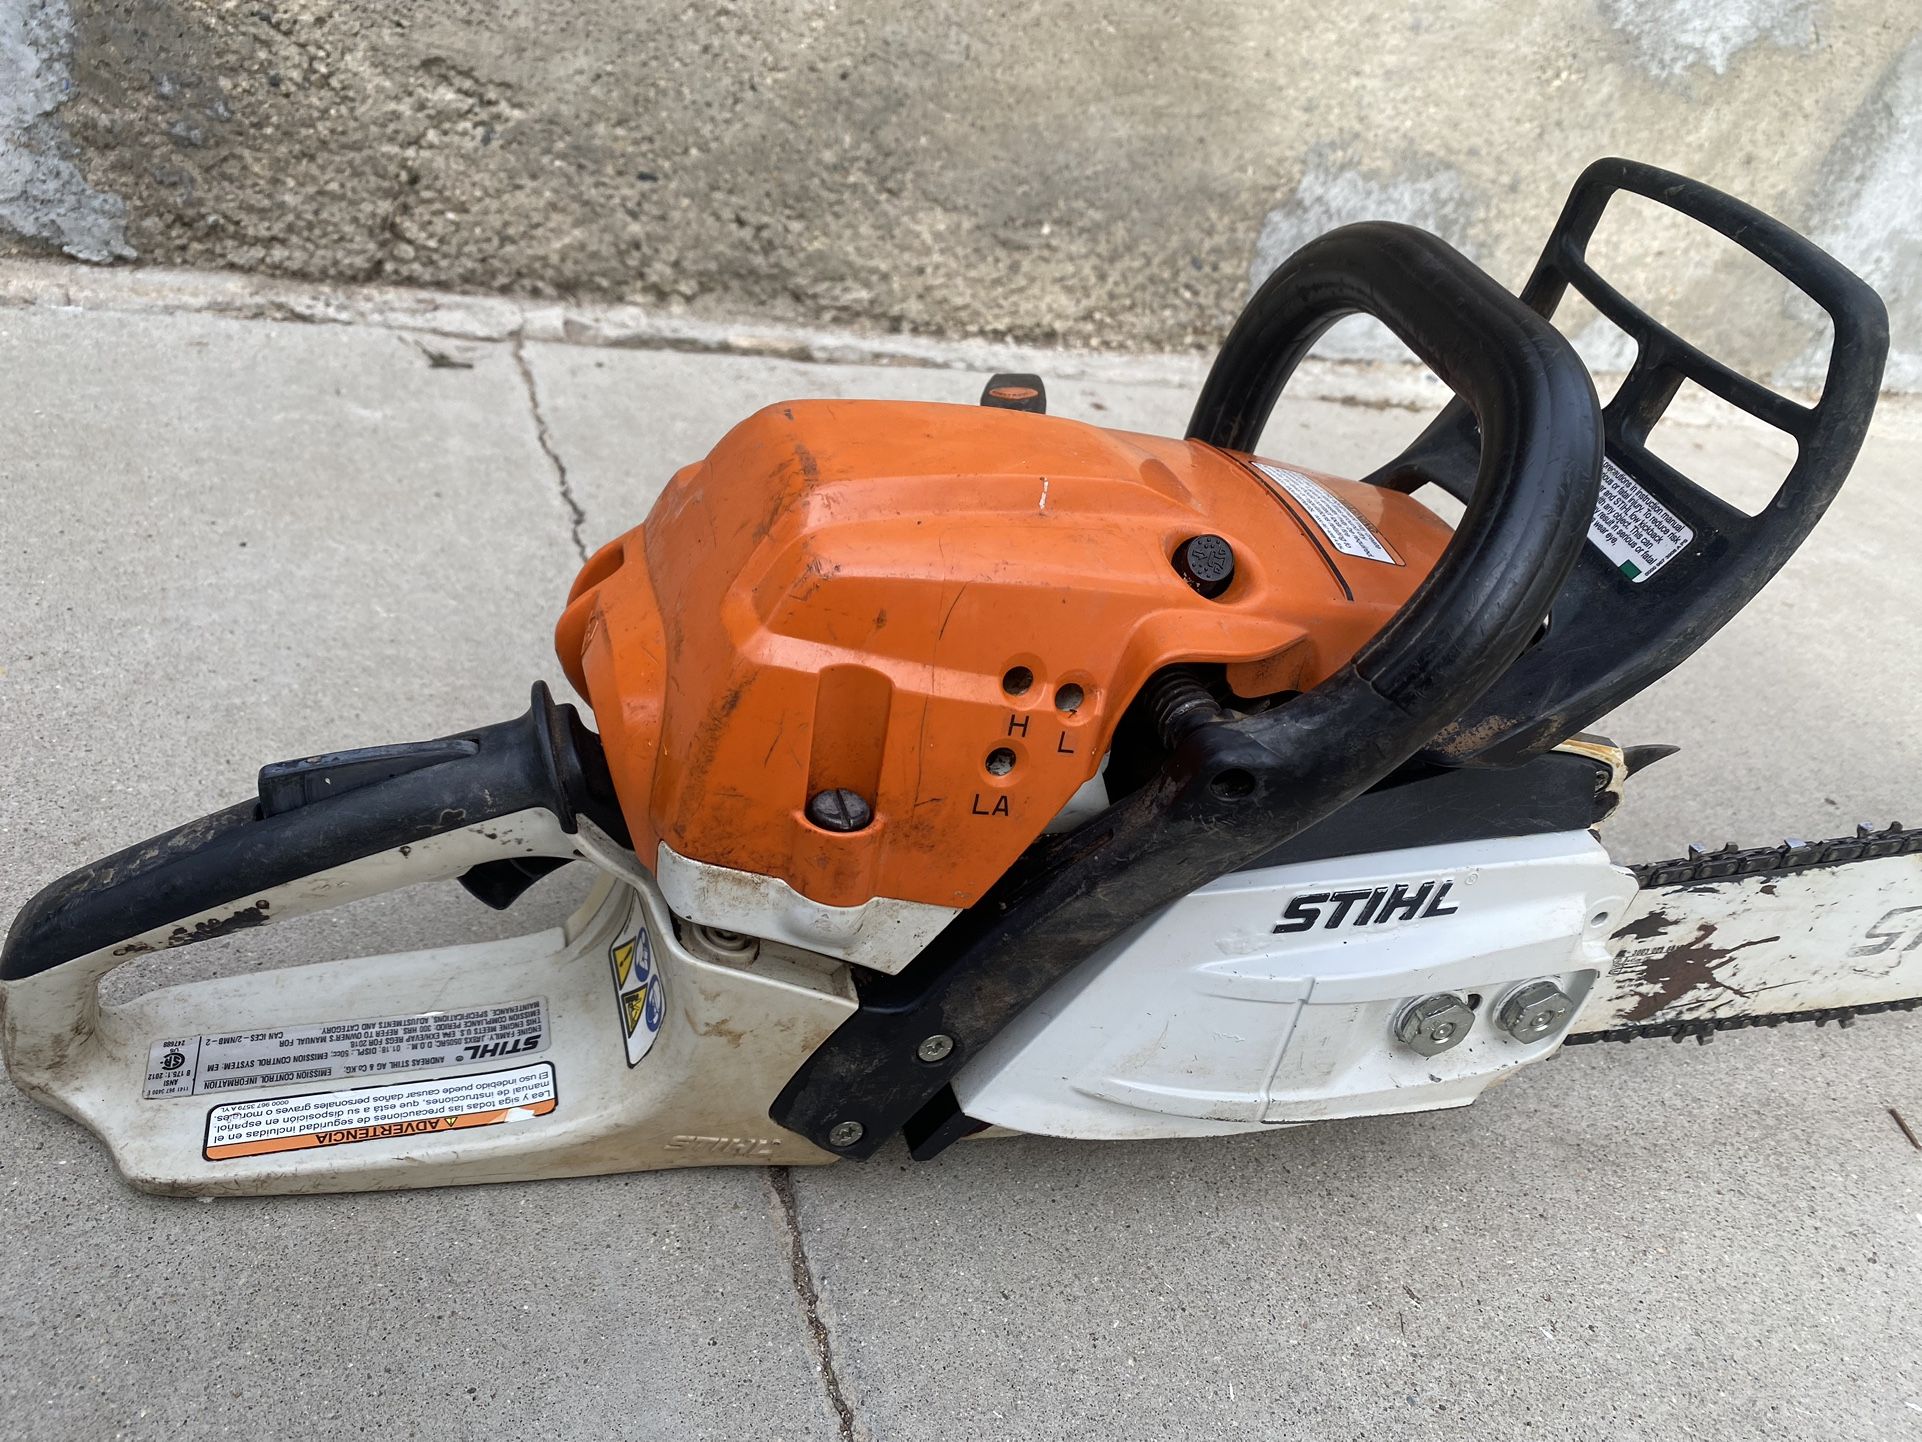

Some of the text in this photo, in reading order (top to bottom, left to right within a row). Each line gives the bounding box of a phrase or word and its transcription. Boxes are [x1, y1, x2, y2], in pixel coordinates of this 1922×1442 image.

[1629, 482, 1638, 493] in
[1634, 487, 1664, 515] instruction
[1660, 512, 1685, 533] manual
[1602, 489, 1616, 502] and
[1613, 497, 1632, 516] STIHL
[1628, 510, 1641, 524] low
[1637, 519, 1664, 545] kickback
[1611, 482, 1620, 491] or
[1616, 486, 1632, 500] fatal
[1626, 495, 1645, 514] injury.
[1642, 507, 1652, 519] To
[1648, 516, 1670, 535] reduce
[1666, 531, 1681, 545] risk
[1602, 503, 1615, 515] any
[1612, 511, 1632, 530] object.
[1629, 524, 1643, 540] This
[1640, 537, 1654, 549] can
[1593, 520, 1609, 535] wear
[1605, 532, 1618, 546] eye,
[1597, 511, 1614, 527] result
[1610, 523, 1619, 532] in
[1616, 528, 1638, 548] serious
[1634, 545, 1644, 554] or
[1640, 550, 1657, 566] fatal
[1008, 714, 1029, 737] H
[1058, 731, 1074, 753] L
[972, 794, 1009, 816] LA
[1272, 879, 1459, 934] STIHL
[507, 1008, 540, 1020] EMISSION
[378, 1017, 429, 1028] ADJUSTMENTS
[463, 1016, 507, 1027] COMPLIANCE
[498, 1020, 523, 1031] ENGINE
[525, 1016, 540, 1025] THIS
[361, 1022, 376, 1030] AND
[473, 1025, 496, 1034] MEETS
[516, 1024, 541, 1035] ENGINE
[268, 1031, 283, 1039] CAN
[329, 1031, 362, 1042] OWNER'S
[375, 1028, 398, 1037] REFER
[405, 1032, 439, 1042] EXH/EVAP
[442, 1030, 455, 1038] EPA
[459, 1028, 471, 1036] U.S.
[279, 1039, 294, 1047] FOR
[296, 1035, 326, 1045] MANUAL
[368, 1038, 383, 1046] FOR
[385, 1036, 403, 1044] REGS
[463, 1034, 542, 1060] STIHL
[256, 1055, 291, 1066] CONTROL
[292, 1052, 328, 1062] EMISSION
[411, 1056, 444, 1066] ANDREAS
[207, 1063, 219, 1072] EM
[376, 1062, 387, 1070] AG
[388, 1059, 409, 1069] STIHL
[147, 1072, 163, 1080] 2012
[203, 1068, 331, 1089] EMISSION CONTROL INFORMATION
[518, 1074, 536, 1083] uso
[538, 1071, 548, 1079] El
[163, 1078, 178, 1086] ANSI
[475, 1078, 516, 1090] indebido
[512, 1080, 550, 1094] manual
[405, 1088, 440, 1098] causar
[442, 1083, 473, 1094] puede
[496, 1089, 509, 1097] de
[372, 1093, 403, 1103] daños
[422, 1091, 494, 1106] instrucciones,
[522, 1093, 528, 1101] y
[531, 1089, 550, 1099] Lea
[313, 1095, 370, 1110] personales
[399, 1100, 419, 1108] que
[466, 1100, 495, 1110] todas
[498, 1096, 519, 1106] siga
[275, 1102, 311, 1114] graves
[373, 1103, 396, 1113] está
[282, 1109, 344, 1124] disposición
[373, 1106, 445, 1122] precauciones
[299, 1118, 353, 1132] seguridad
[356, 1116, 370, 1125] de
[214, 1120, 262, 1133] español.
[245, 1125, 295, 1138] incluidas
[315, 1118, 440, 1144] ADVERTENCIA
[214, 1135, 224, 1143] el
[228, 1132, 242, 1140] en
[664, 1135, 772, 1155] STIHL
